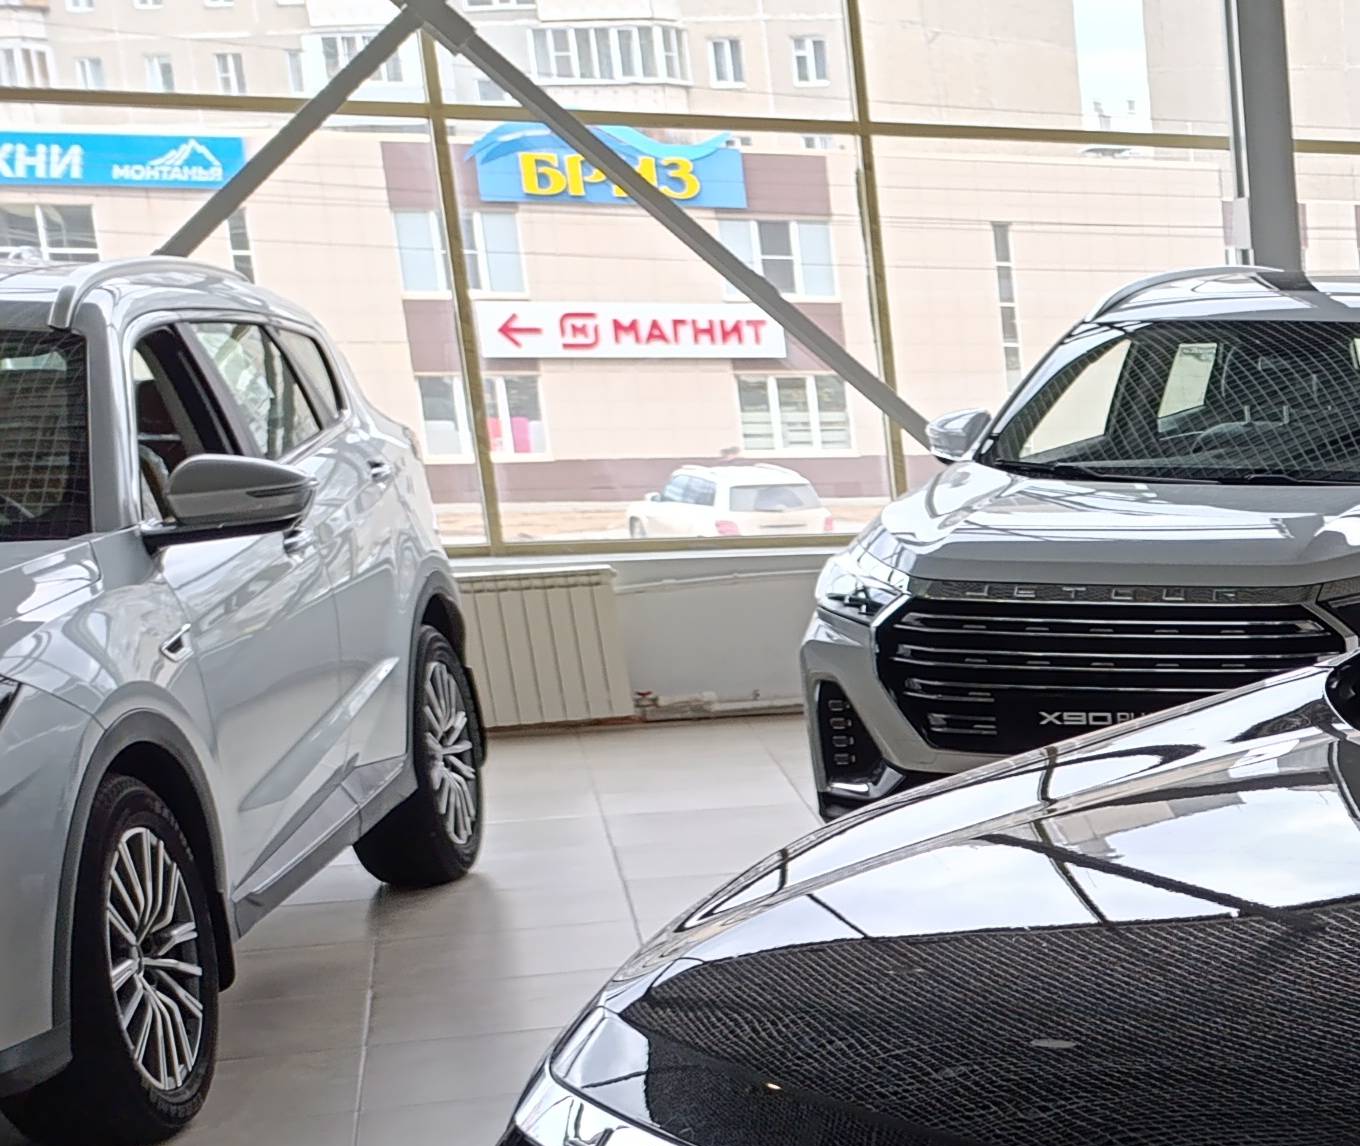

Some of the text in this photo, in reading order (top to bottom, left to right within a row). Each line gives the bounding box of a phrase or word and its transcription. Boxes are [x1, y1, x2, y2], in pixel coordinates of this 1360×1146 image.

[112, 164, 223, 181] МОНТАНЬЯ
[612, 318, 767, 346] МАГНИТ
[1038, 711, 1113, 725] X90
